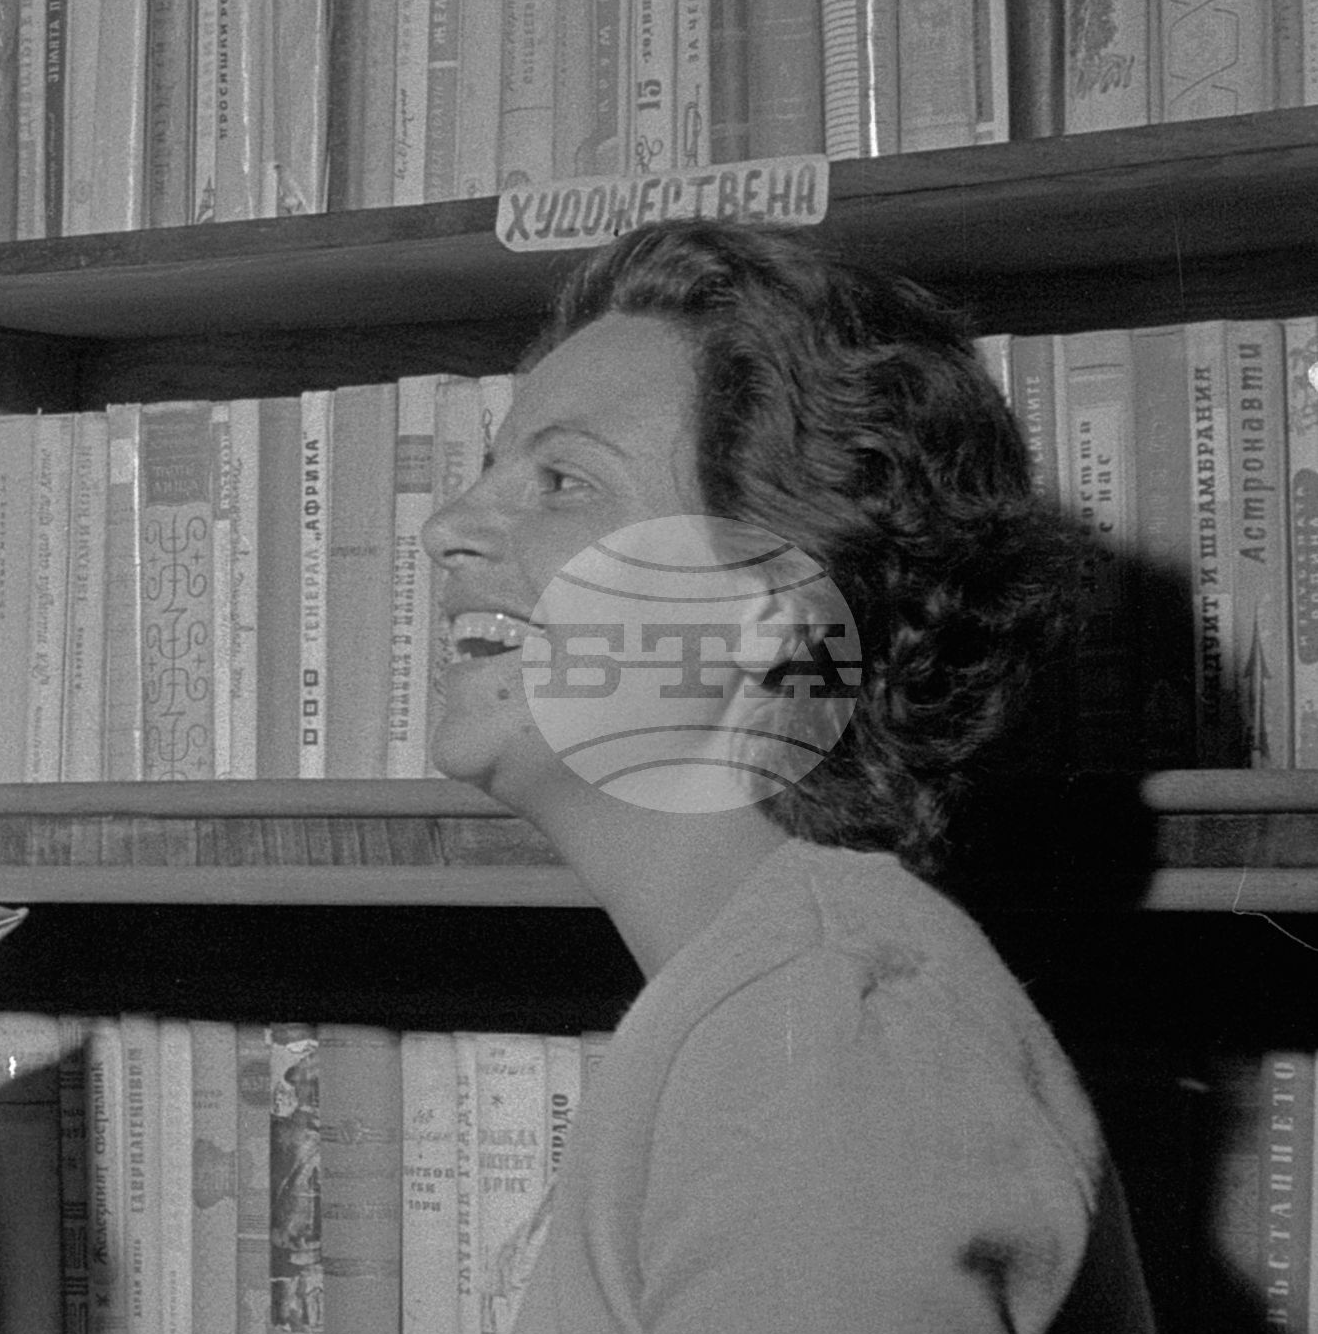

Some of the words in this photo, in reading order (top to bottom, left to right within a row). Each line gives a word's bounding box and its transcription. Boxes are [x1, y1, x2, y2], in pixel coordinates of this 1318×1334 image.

[48, 19, 62, 83] ЗЕМЯТА
[687, 38, 700, 64] ЗА
[507, 169, 817, 242] ХУДОЖЕСТВЕНА
[1024, 374, 1045, 464] СМЕЛИТЕ
[1193, 366, 1218, 560] ШВАМБРАНИЯ
[1238, 344, 1275, 565] Астронавти
[304, 546, 320, 644] ГЕНЕРАЛ
[1199, 567, 1218, 586] И
[1265, 1061, 1296, 1327] ВЪСТАНИЕТО
